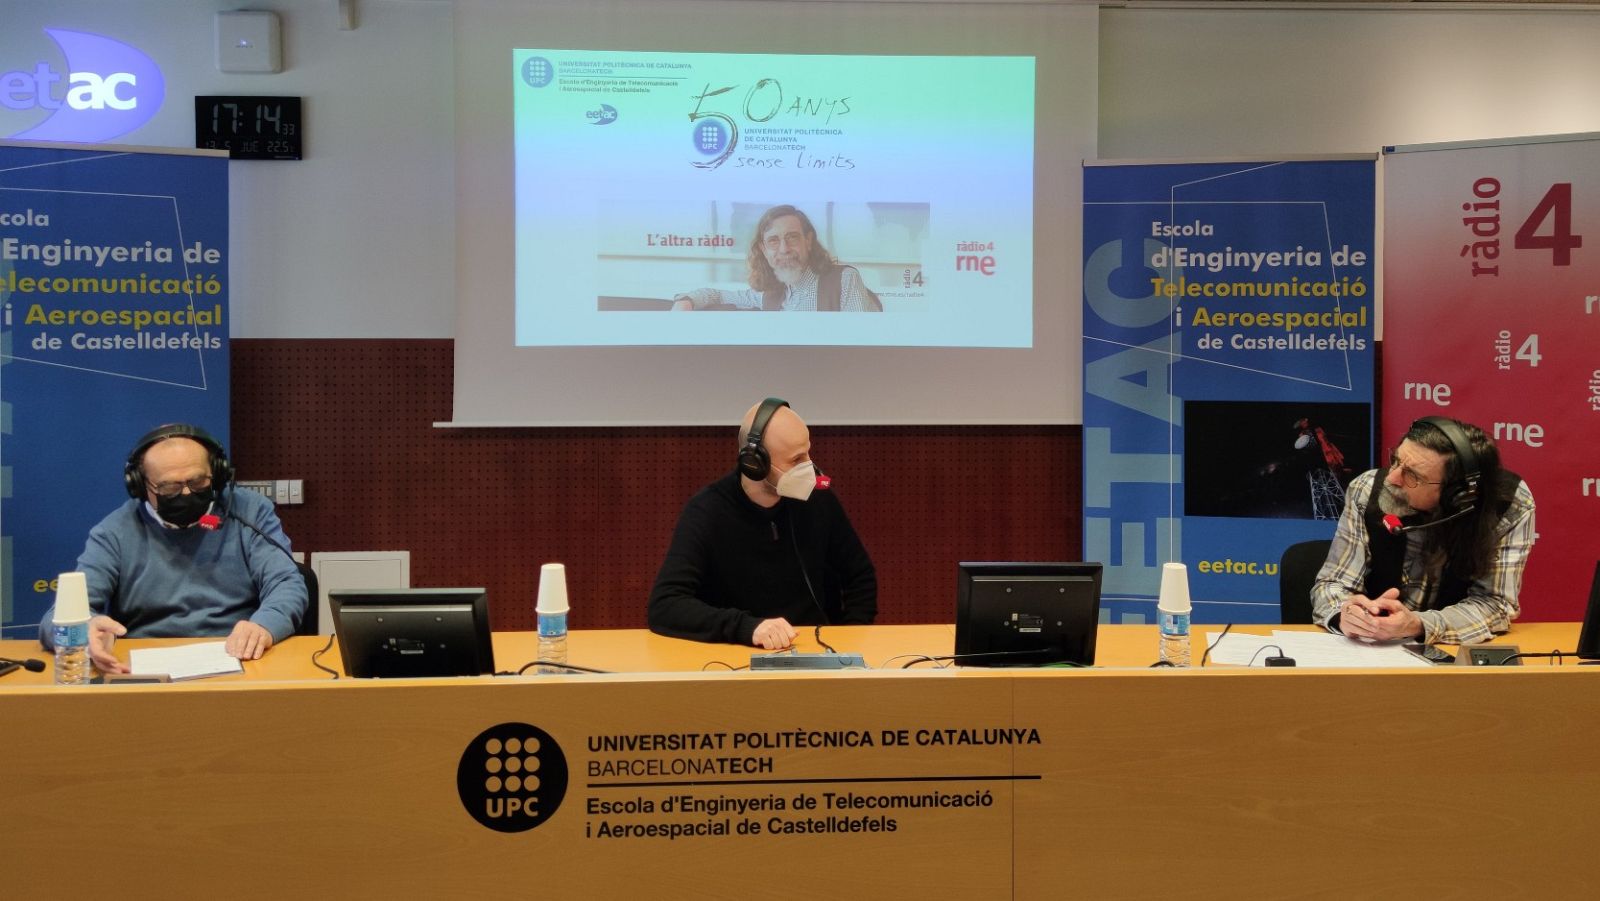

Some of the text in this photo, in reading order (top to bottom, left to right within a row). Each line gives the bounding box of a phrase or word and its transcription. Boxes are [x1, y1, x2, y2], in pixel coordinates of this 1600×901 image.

[212, 103, 295, 135] 17:14 33
[586, 108, 616, 119] eetac
[785, 96, 853, 126] ANYS
[734, 152, 856, 169] sense limits
[0, 208, 49, 227] cola
[1151, 220, 1214, 237] Escola
[1459, 176, 1583, 278] ràdio 4
[647, 233, 734, 247] L'altra ràdio
[956, 241, 995, 252] ràdio 4
[183, 241, 222, 264] de
[1151, 245, 1367, 272] d'Enginyeria de
[956, 254, 996, 276] rne
[912, 271, 924, 288] 4
[1150, 276, 1367, 298] Telecomunicació
[5, 303, 222, 330] i Aeroespacial
[1176, 305, 1367, 332] i Aeroespacial
[31, 332, 222, 350] de Castelldefels
[1197, 333, 1367, 351] de Castelldefels
[1494, 330, 1542, 371] ràdio 4
[1404, 381, 1452, 406] rne
[1084, 237, 1184, 624] ETAC
[1493, 421, 1545, 448] rne
[587, 727, 1042, 753] UNIVERSITAT POLITÈCNICA DE CATALUNYA
[587, 756, 774, 778] BARCELONATECH
[486, 797, 540, 818] UPC
[586, 788, 993, 819] Escola d'Enginyeria de Telecomunicació
[586, 815, 898, 842] i Aeroespacial de Castelldefels
